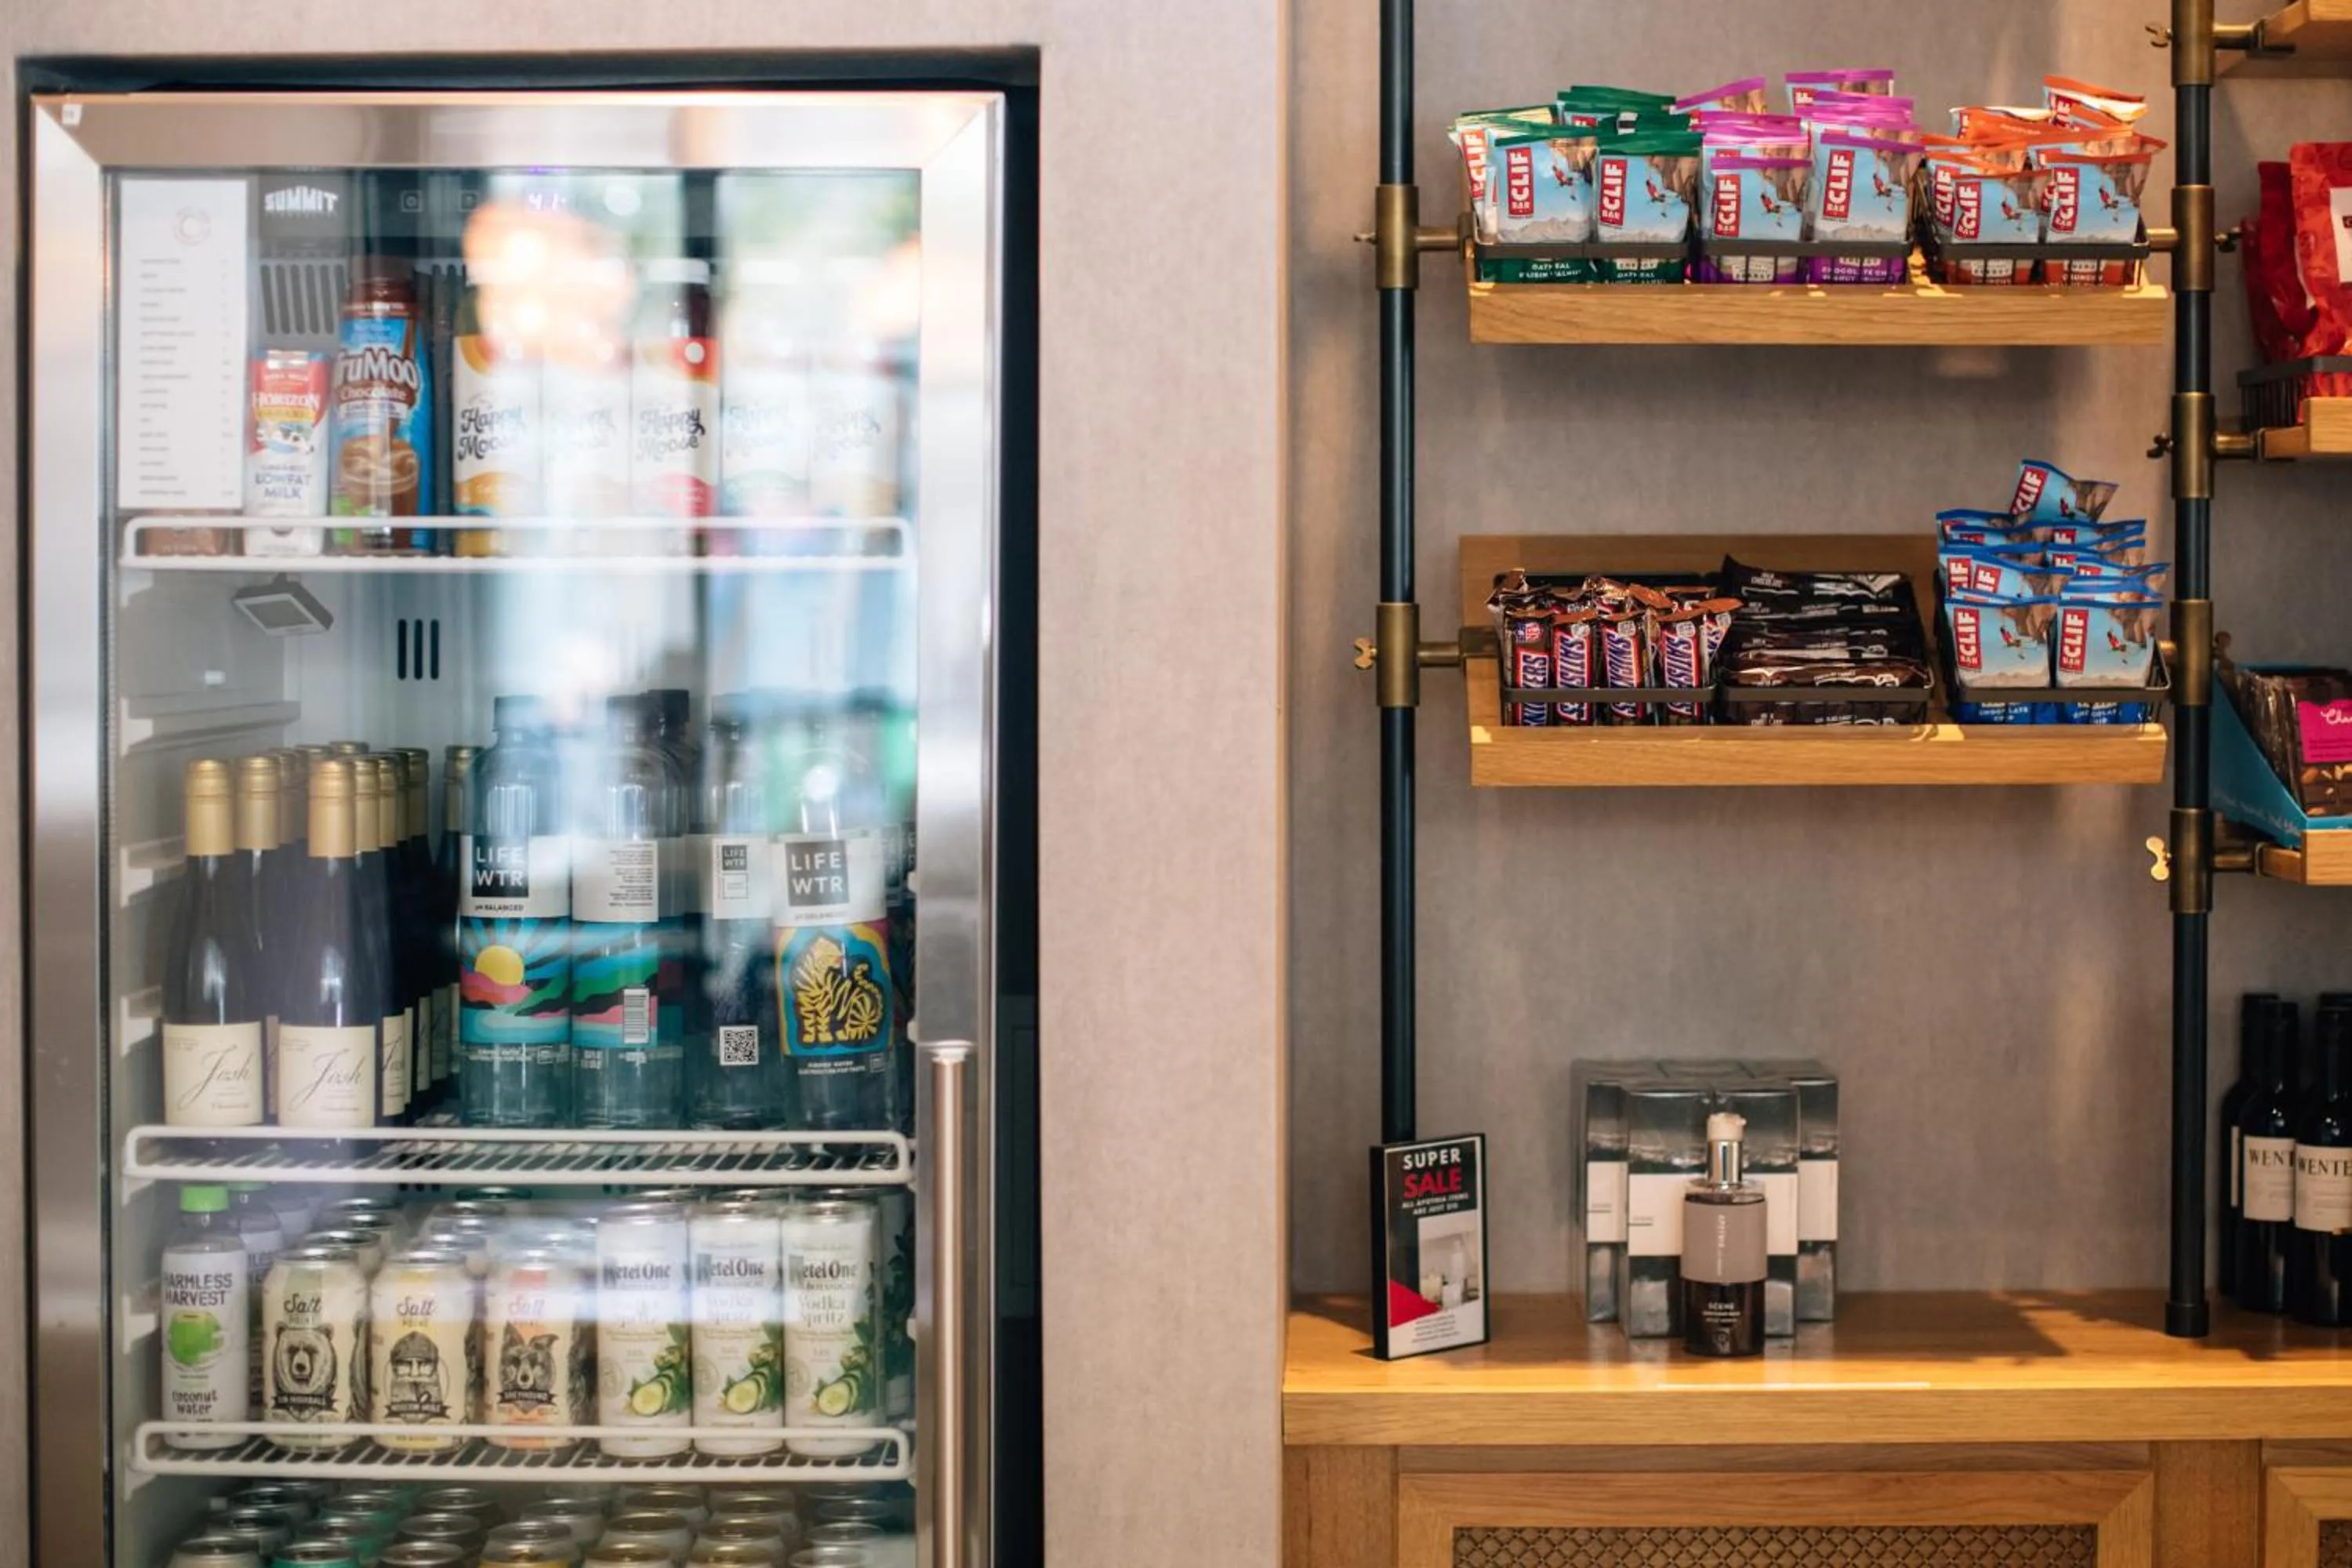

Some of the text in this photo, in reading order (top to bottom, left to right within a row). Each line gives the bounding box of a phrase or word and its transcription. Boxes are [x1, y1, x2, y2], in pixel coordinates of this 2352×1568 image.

[1464, 132, 1487, 186] CLIF
[1509, 151, 1530, 201] CLIF
[1602, 162, 1623, 212] CLIF
[1828, 153, 1851, 205] CLIF
[264, 186, 339, 212] SUMMIT
[1718, 179, 1737, 225] CLIF
[1936, 169, 1953, 213] CLIF
[2056, 171, 2076, 220] CLIF
[1958, 185, 1979, 227] CLIF
[252, 393, 321, 409] HORIZON
[461, 405, 528, 434] Happy
[639, 406, 706, 437] Happy
[634, 433, 700, 463] Moose
[255, 472, 312, 485] LOWFAT
[263, 487, 302, 499] MILK
[2016, 470, 2042, 512] CLIF
[1957, 612, 1977, 656] CLIF
[2063, 612, 2084, 656] CLIF
[1608, 633, 1635, 714] SNICKS
[1666, 636, 1693, 714] SATISFS
[1979, 706, 2028, 716] CHOCLATE
[476, 847, 524, 863] LIFE
[790, 851, 842, 871] LIFE
[476, 869, 524, 887] WTR
[791, 875, 844, 895] WTR
[1403, 1147, 1461, 1171] SUPER
[2249, 1149, 2296, 1167] WENT
[1404, 1167, 1462, 1200] SALE
[1402, 1200, 1415, 1209] ALL
[1413, 1207, 1427, 1215] ARE
[643, 1263, 671, 1280] One
[736, 1258, 765, 1277] One
[829, 1260, 858, 1279] One
[165, 1290, 227, 1307] HARVEST
[284, 1292, 322, 1313] Salt
[396, 1296, 437, 1316] Salt
[509, 1294, 546, 1316] Salt
[172, 1389, 218, 1403] coconut
[177, 1403, 212, 1415] water
